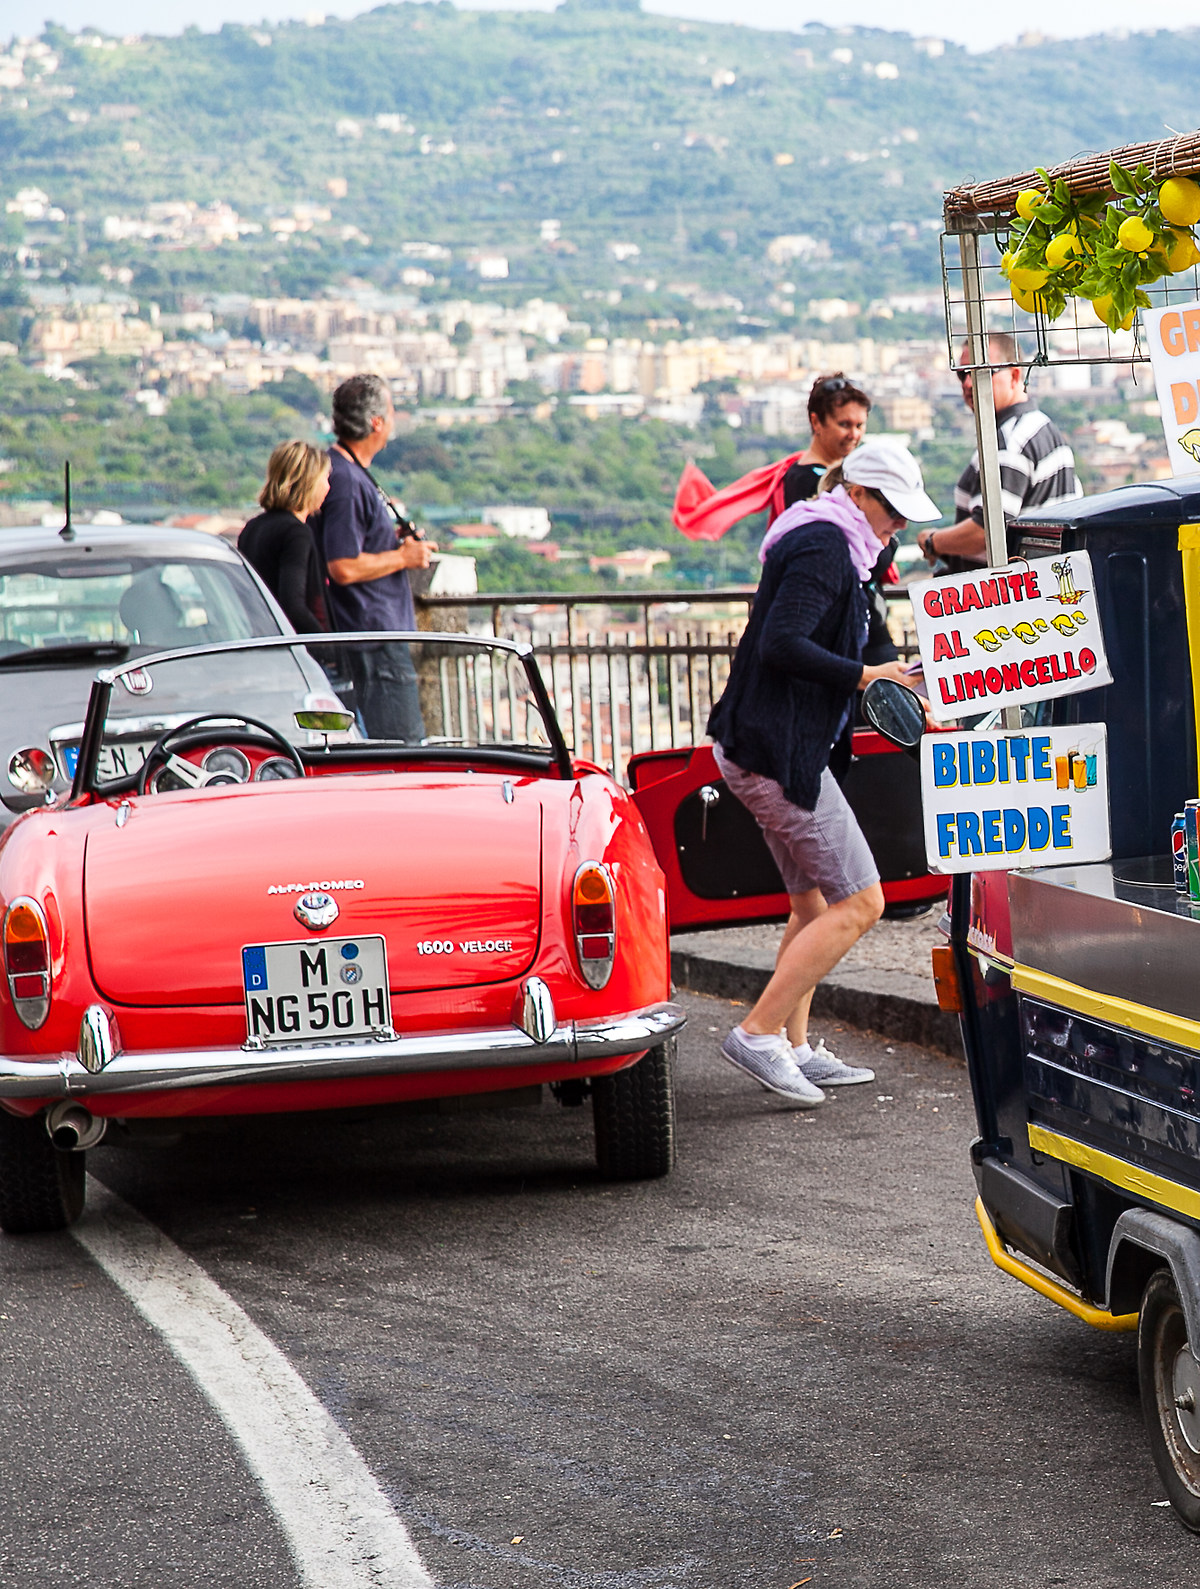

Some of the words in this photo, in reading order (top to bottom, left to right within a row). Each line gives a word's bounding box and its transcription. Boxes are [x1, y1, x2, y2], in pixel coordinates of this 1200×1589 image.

[923, 570, 1041, 618] GRANITE
[933, 629, 970, 662] AL
[938, 647, 1097, 705] LIMONCELLO
[932, 736, 1053, 789] BIBITE
[936, 804, 1073, 859] FREDDE
[416, 940, 454, 955] 1600
[459, 939, 513, 954] VELOCE
[252, 974, 261, 986] D
[300, 948, 328, 987] M
[251, 995, 301, 1035] NG
